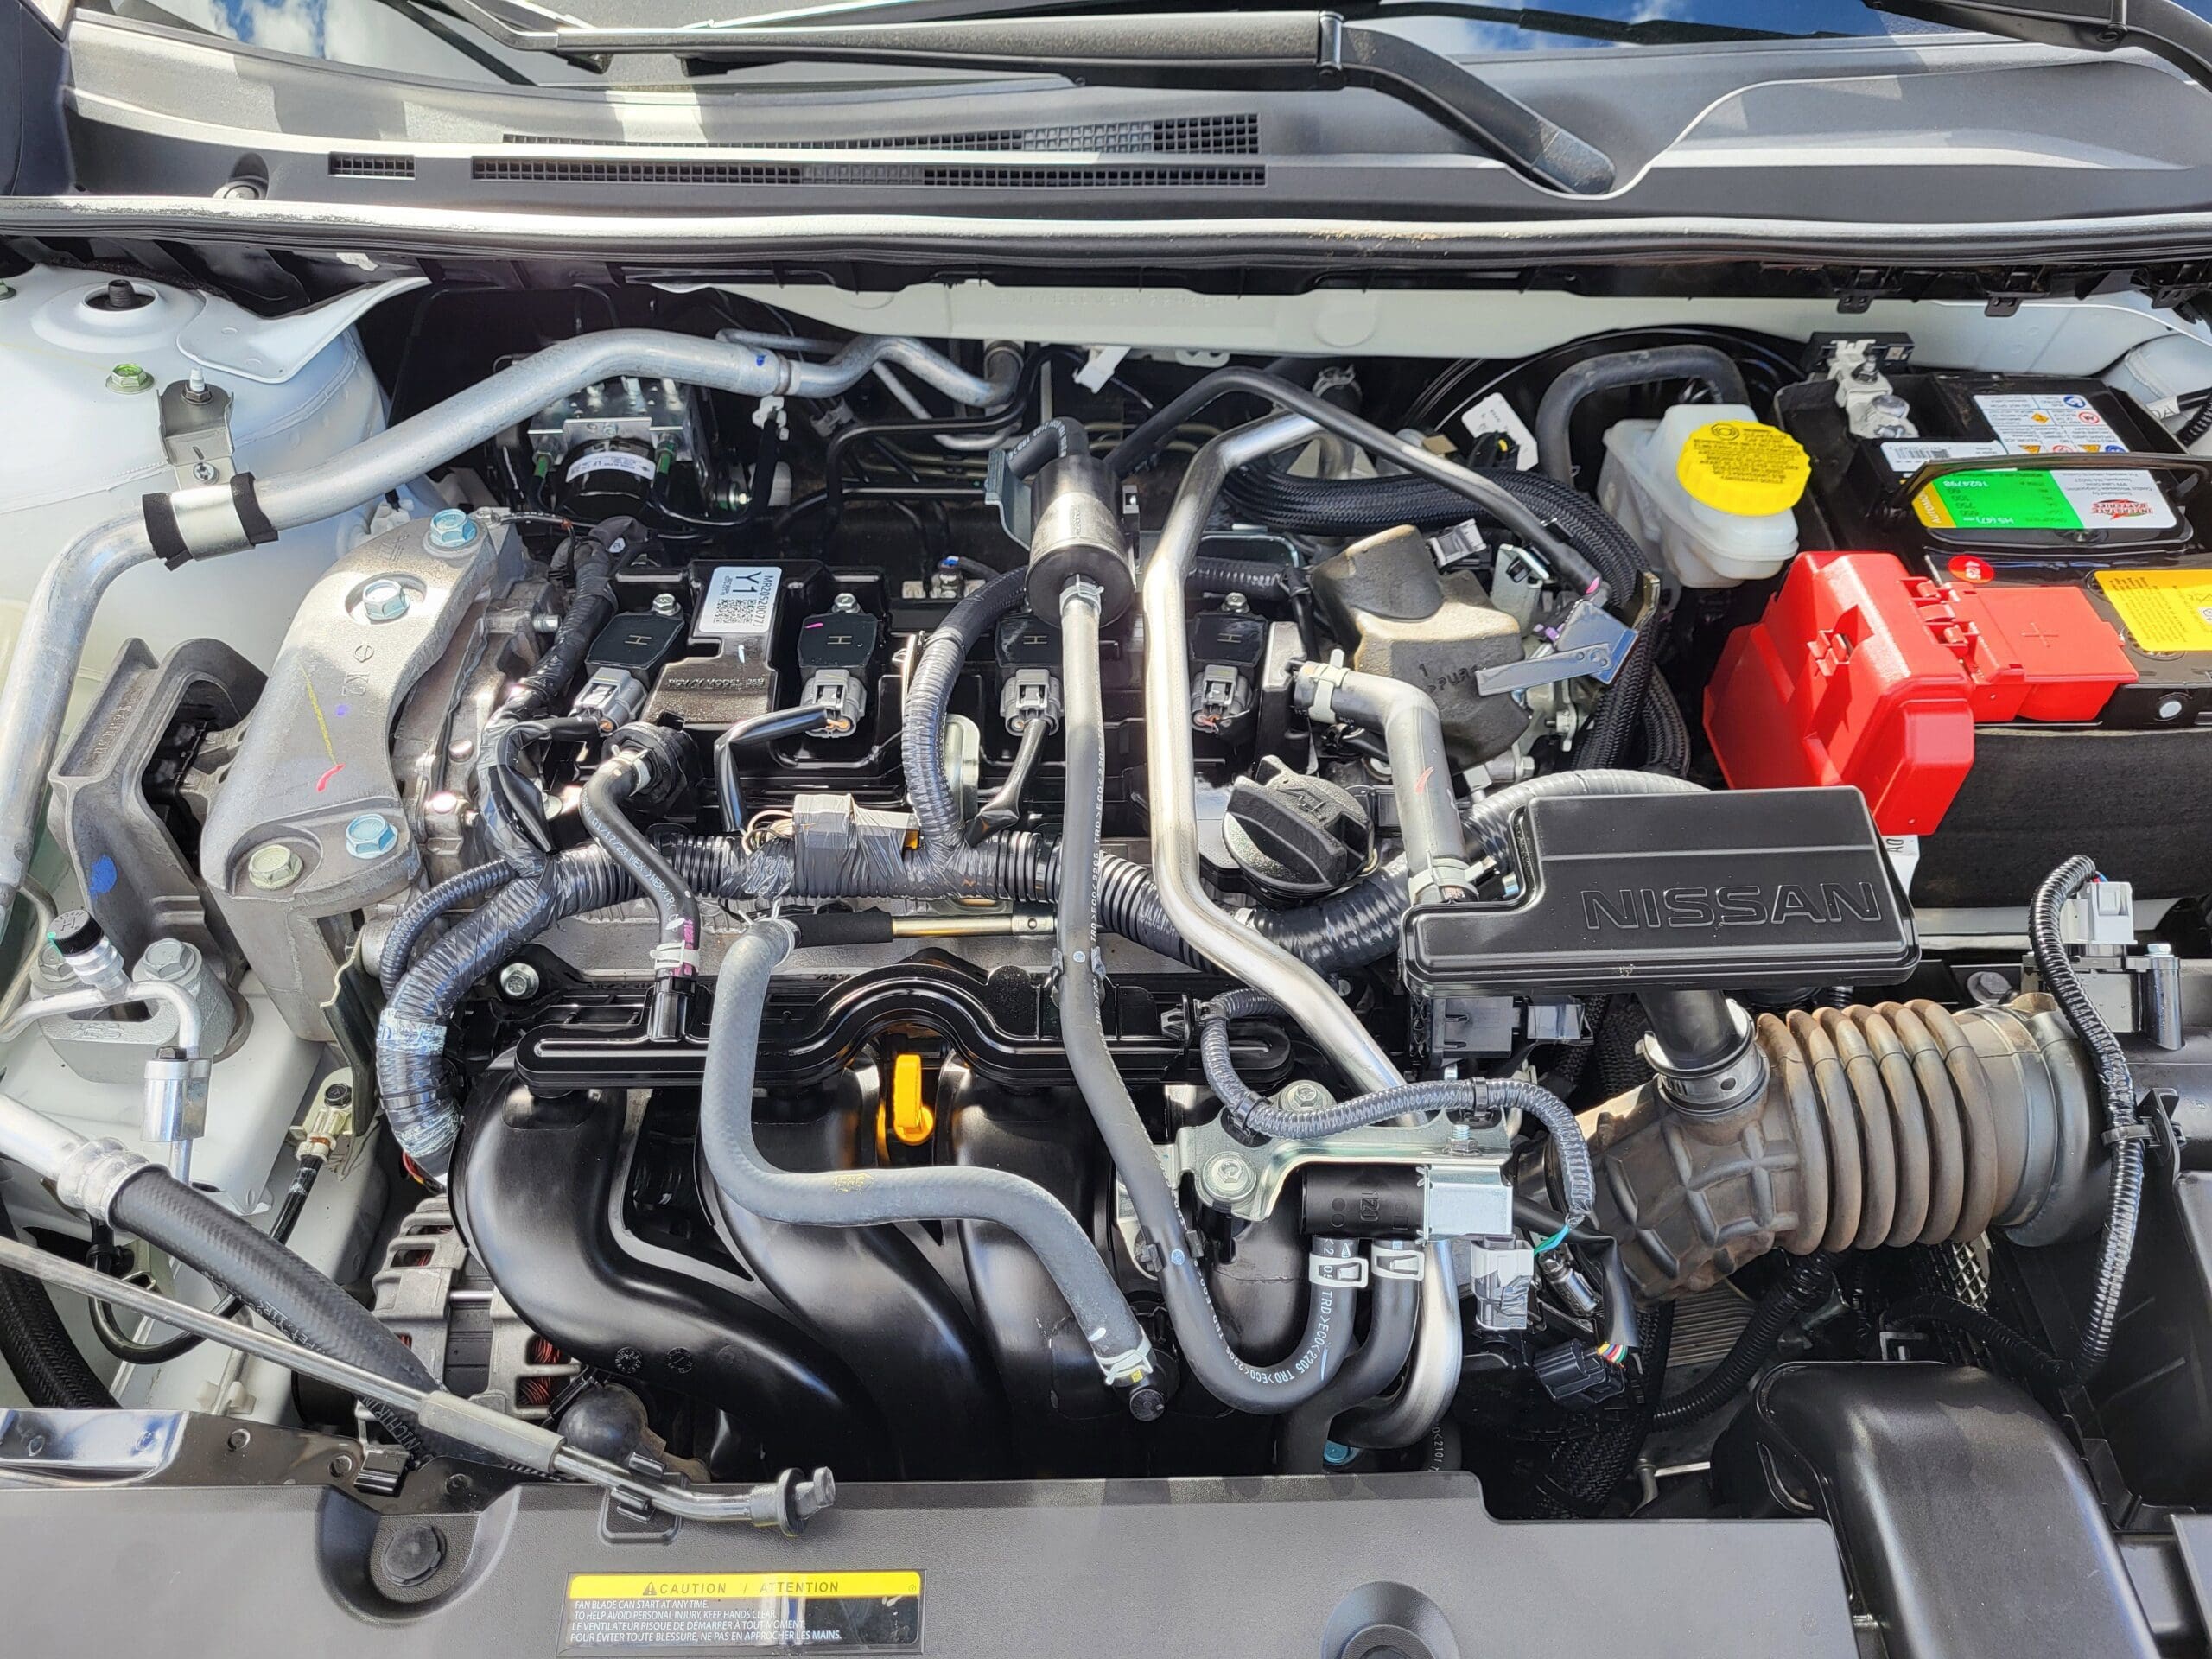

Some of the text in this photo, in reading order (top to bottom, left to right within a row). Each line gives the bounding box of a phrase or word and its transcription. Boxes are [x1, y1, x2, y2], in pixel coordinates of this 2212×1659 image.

[733, 571, 761, 593] Y1
[591, 817, 629, 857] 01/17/23
[629, 854, 647, 872] MEX
[1580, 882, 1882, 930] NISSAN
[1296, 1290, 1333, 1375] TRD>ECO<2205
[362, 1395, 422, 1451] NICHIRIN
[659, 1582, 727, 1594] CAUTION
[760, 1581, 839, 1593] ATTENTION
[575, 1600, 591, 1609] FAN
[592, 1600, 616, 1609] BLADE
[619, 1600, 635, 1609] CAN
[637, 1600, 659, 1609] START
[607, 1611, 632, 1619] AVOID
[633, 1611, 672, 1619] PERSONAL
[675, 1611, 702, 1620] INJURY,
[572, 1623, 582, 1631] LE
[584, 1622, 639, 1631] VENTILATEUR
[641, 1622, 671, 1630] RISQUE
[686, 1620, 733, 1630] DÉMARRER
[734, 1619, 740, 1629] À
[742, 1621, 763, 1630] TOUT
[766, 1620, 805, 1629] MOMENT.
[570, 1633, 594, 1642] POUR
[597, 1632, 624, 1642] ÉVITER
[656, 1632, 698, 1642] BLESSURE,
[744, 1631, 794, 1640] APPROCHER
[812, 1630, 842, 1639] MAINS.
